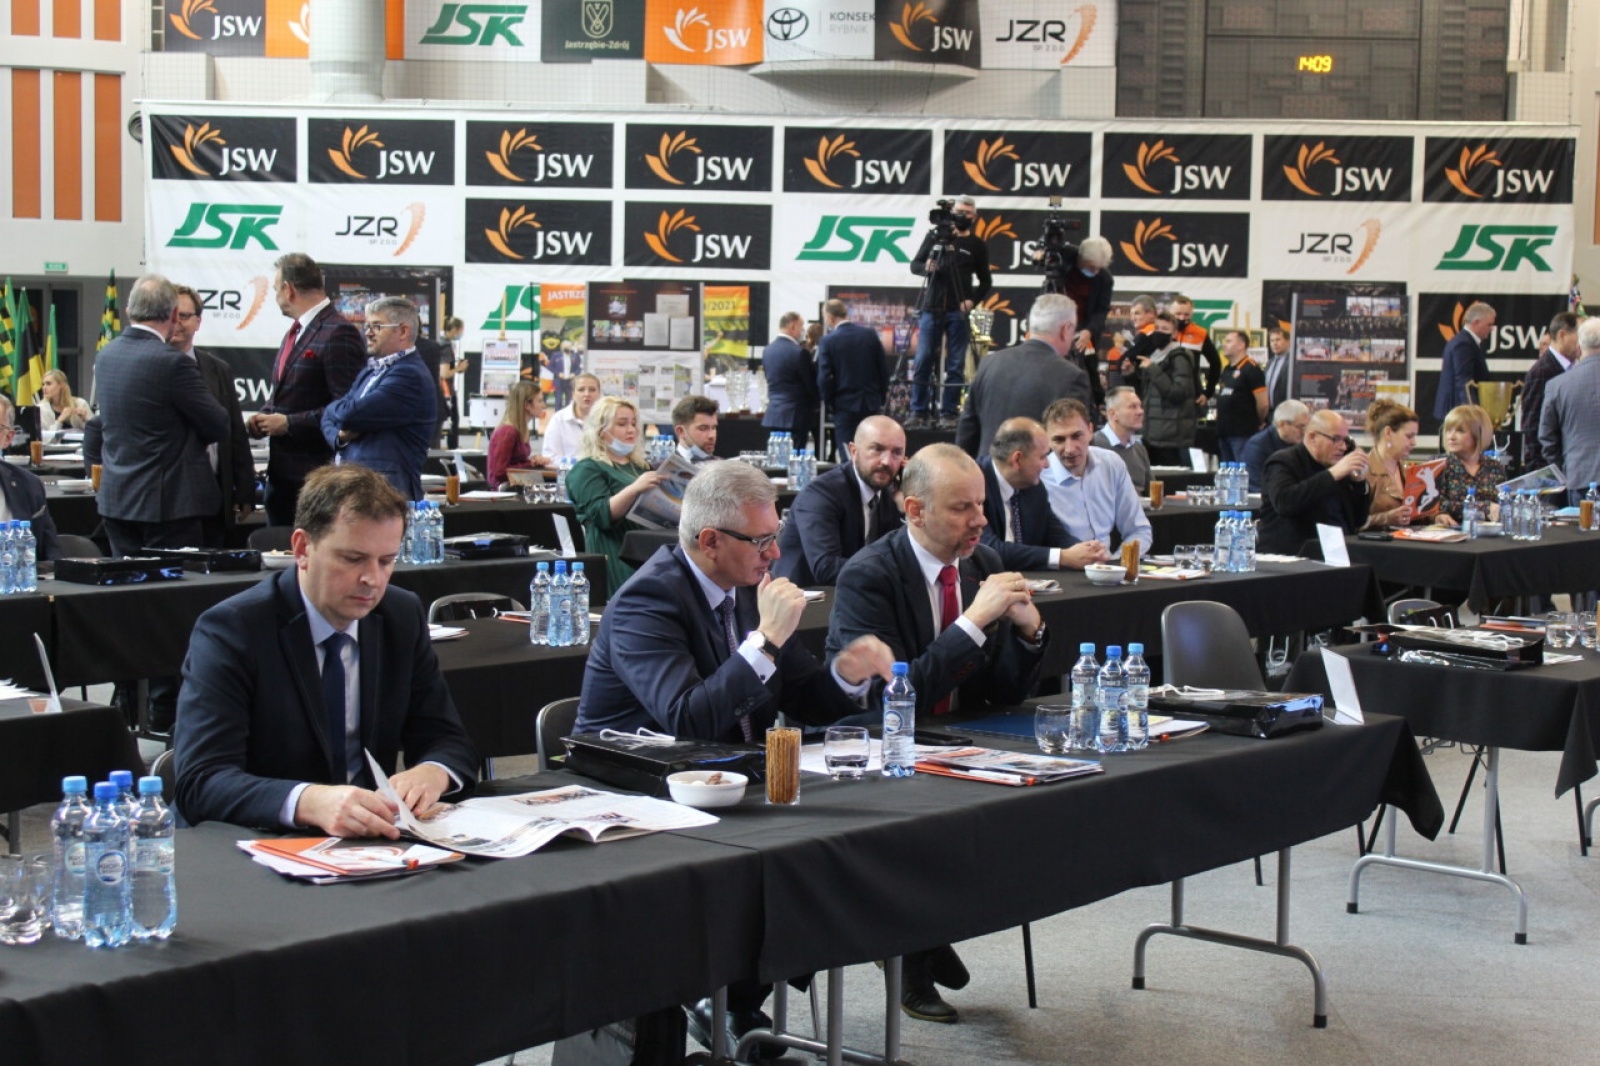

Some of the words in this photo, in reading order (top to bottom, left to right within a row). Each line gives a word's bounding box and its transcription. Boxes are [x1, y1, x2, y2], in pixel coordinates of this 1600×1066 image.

[211, 15, 262, 40] JSW
[419, 4, 528, 46] JSK
[931, 25, 973, 51] JSW
[995, 19, 1066, 42] JZR
[704, 28, 751, 52] JSW
[220, 148, 277, 176] JSW
[376, 150, 435, 179] JSW
[534, 153, 594, 182] JSW
[694, 156, 753, 185] JSW
[852, 160, 912, 188] JSW
[1011, 163, 1071, 191] JSW
[1171, 165, 1231, 194] JSW
[1332, 167, 1392, 196] JSW
[1494, 169, 1554, 198] JSW
[166, 203, 283, 250] JSK
[335, 215, 398, 236] JZR
[795, 215, 916, 263] JSK
[533, 231, 592, 260] JSW
[692, 234, 752, 263] JSW
[1009, 240, 1037, 269] JS
[1169, 243, 1229, 272] JSW
[1288, 233, 1353, 254] JZR
[1434, 225, 1558, 271] JSK
[198, 290, 241, 310] ZR
[480, 285, 541, 330] JS
[1486, 325, 1547, 354] JSW
[233, 377, 274, 402] SW
